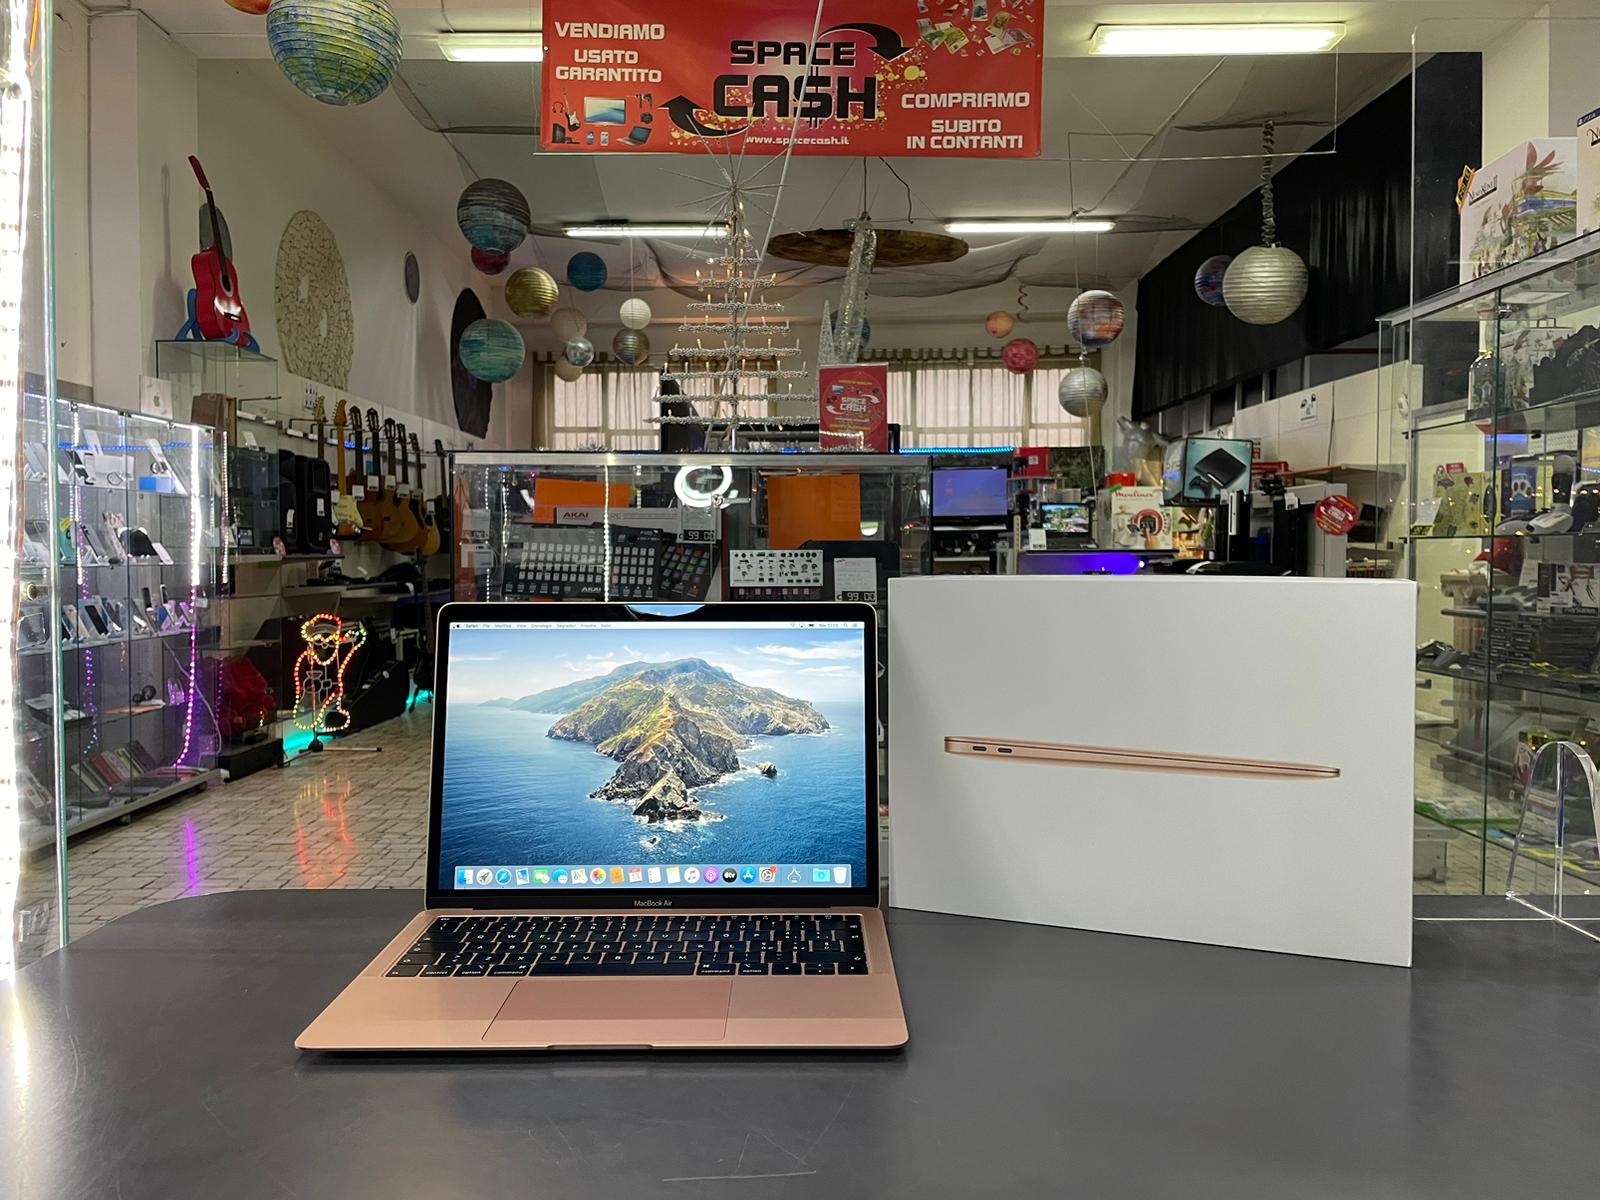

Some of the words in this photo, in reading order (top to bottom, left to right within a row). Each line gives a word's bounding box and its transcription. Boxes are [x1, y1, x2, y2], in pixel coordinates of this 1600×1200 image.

[554, 22, 665, 40] VENDIAMO
[574, 49, 639, 64] USATO
[730, 40, 856, 66] SPACE
[555, 66, 662, 83] GARANTITO
[901, 92, 1030, 109] COMPRIAMO
[931, 119, 1002, 133] SUBITO
[746, 136, 850, 145] www.spacecash.it
[906, 136, 925, 149] IN
[930, 135, 1023, 149] CONTANTI
[562, 511, 589, 519] AKAI
[633, 899, 662, 907] MacBook
[663, 899, 673, 907] Air
